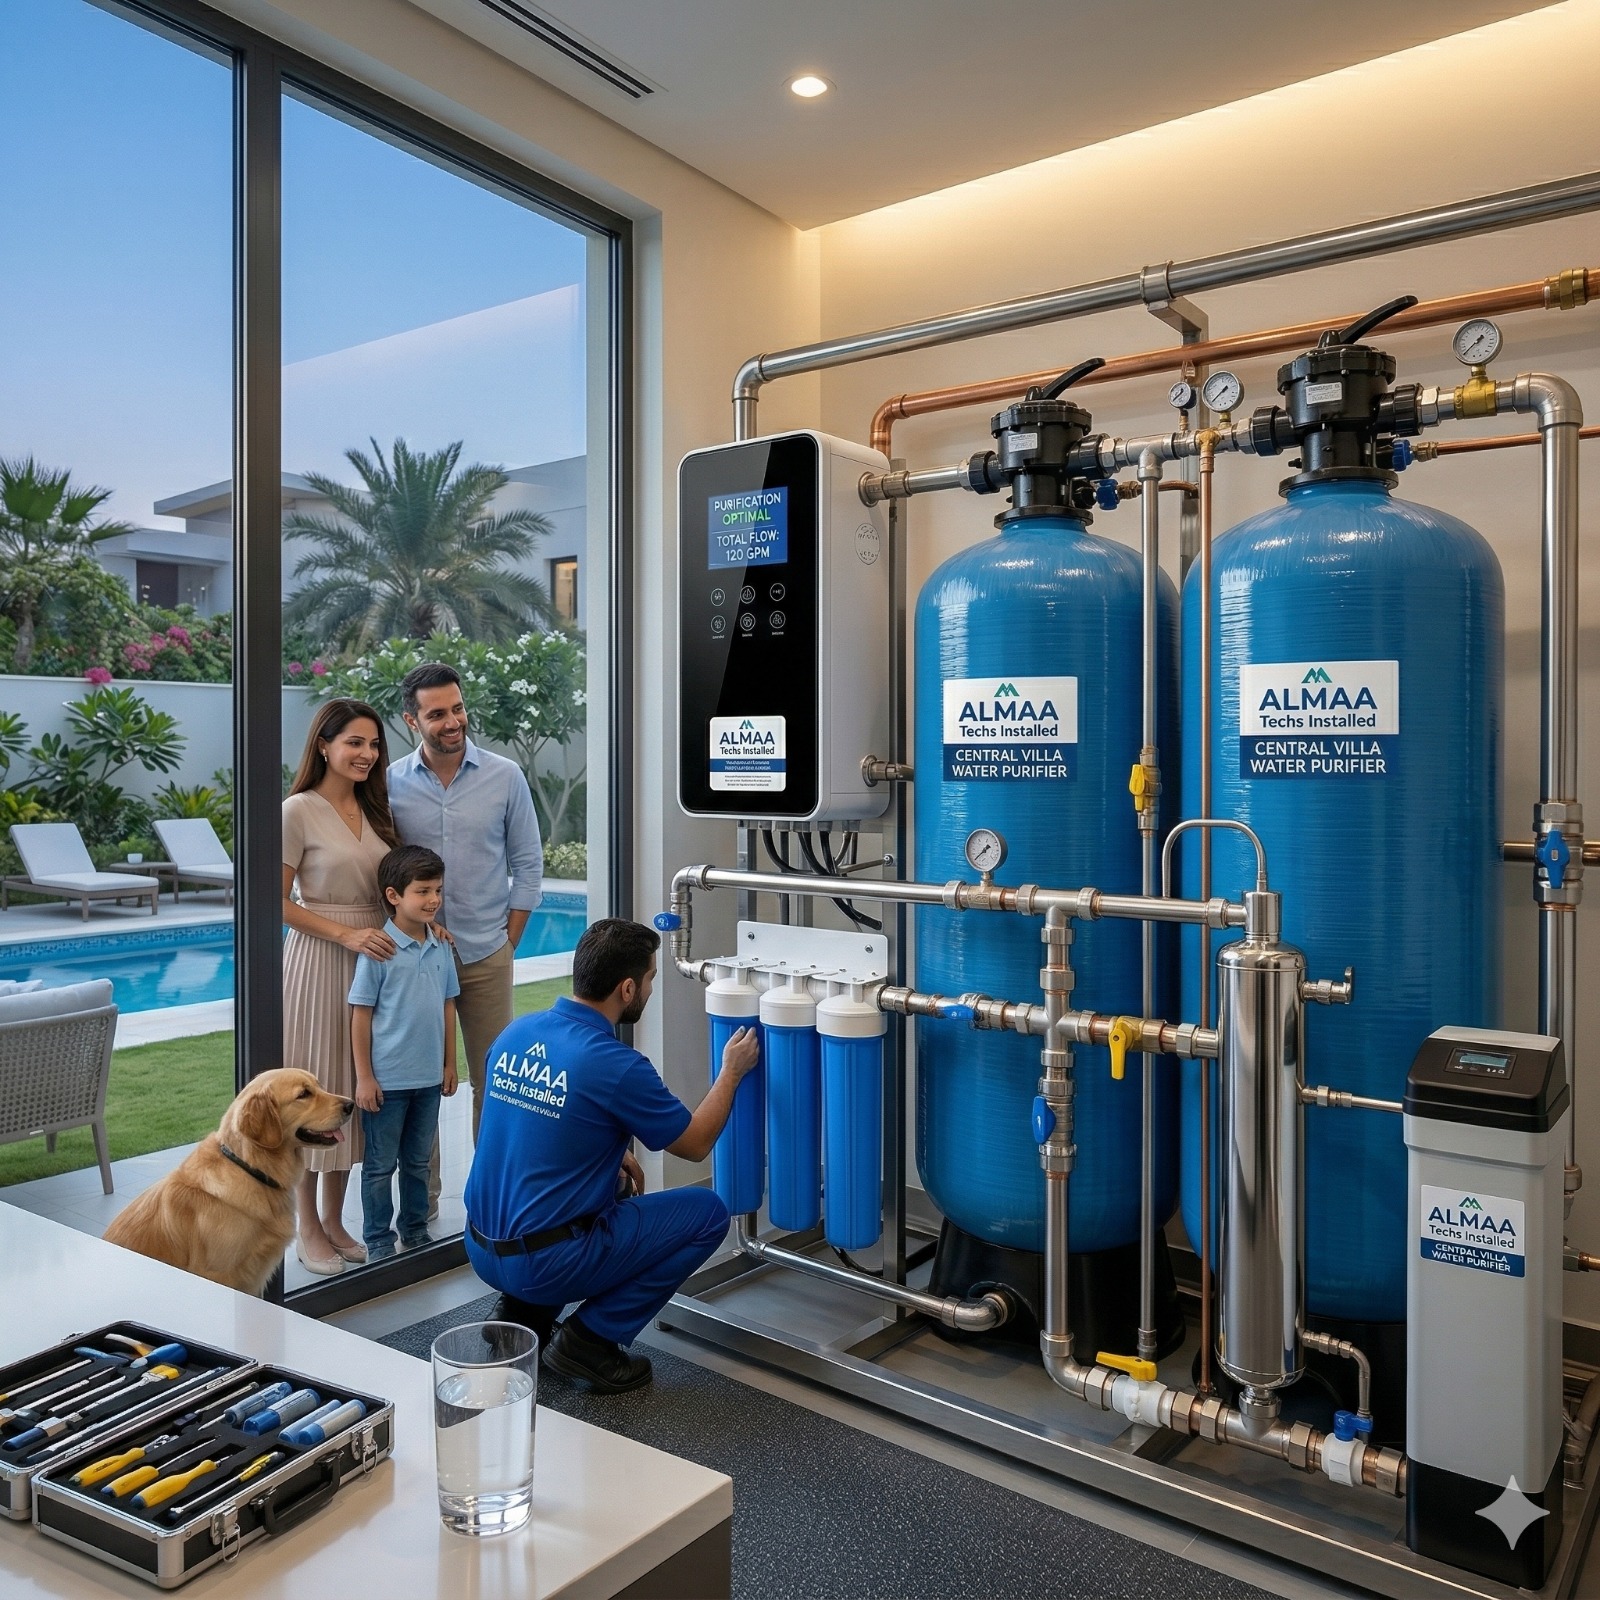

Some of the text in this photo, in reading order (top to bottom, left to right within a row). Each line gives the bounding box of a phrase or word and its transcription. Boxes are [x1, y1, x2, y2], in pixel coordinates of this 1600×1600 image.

[714, 492, 781, 511] PURIFICATION
[722, 508, 771, 525] OPTIMAL
[717, 529, 780, 547] TOTAL FLOW:
[726, 546, 770, 562] 120 GPM
[1258, 687, 1378, 711] ALMAA
[958, 700, 1059, 722] ALMAA
[1259, 713, 1376, 728] Techs Installed
[719, 731, 775, 745] ALMAA
[959, 724, 1058, 737] Techs Installed
[720, 746, 775, 755] Techs Installed
[955, 749, 1063, 762] CENTRAL VILLA
[1254, 741, 1382, 756] CENTRAL VILLA
[952, 764, 1068, 778] WATER PURIFIER
[1250, 759, 1387, 774] WATER PURIFIER
[494, 1051, 568, 1093] ALMAA
[492, 1073, 518, 1093] Techs
[519, 1082, 567, 1108] Installed
[1428, 1206, 1517, 1237] ALMAA
[1429, 1224, 1515, 1249] Techs Installed
[1431, 1249, 1511, 1273] WATER PURIFIER
[1480, 1251, 1508, 1263] VILLA
